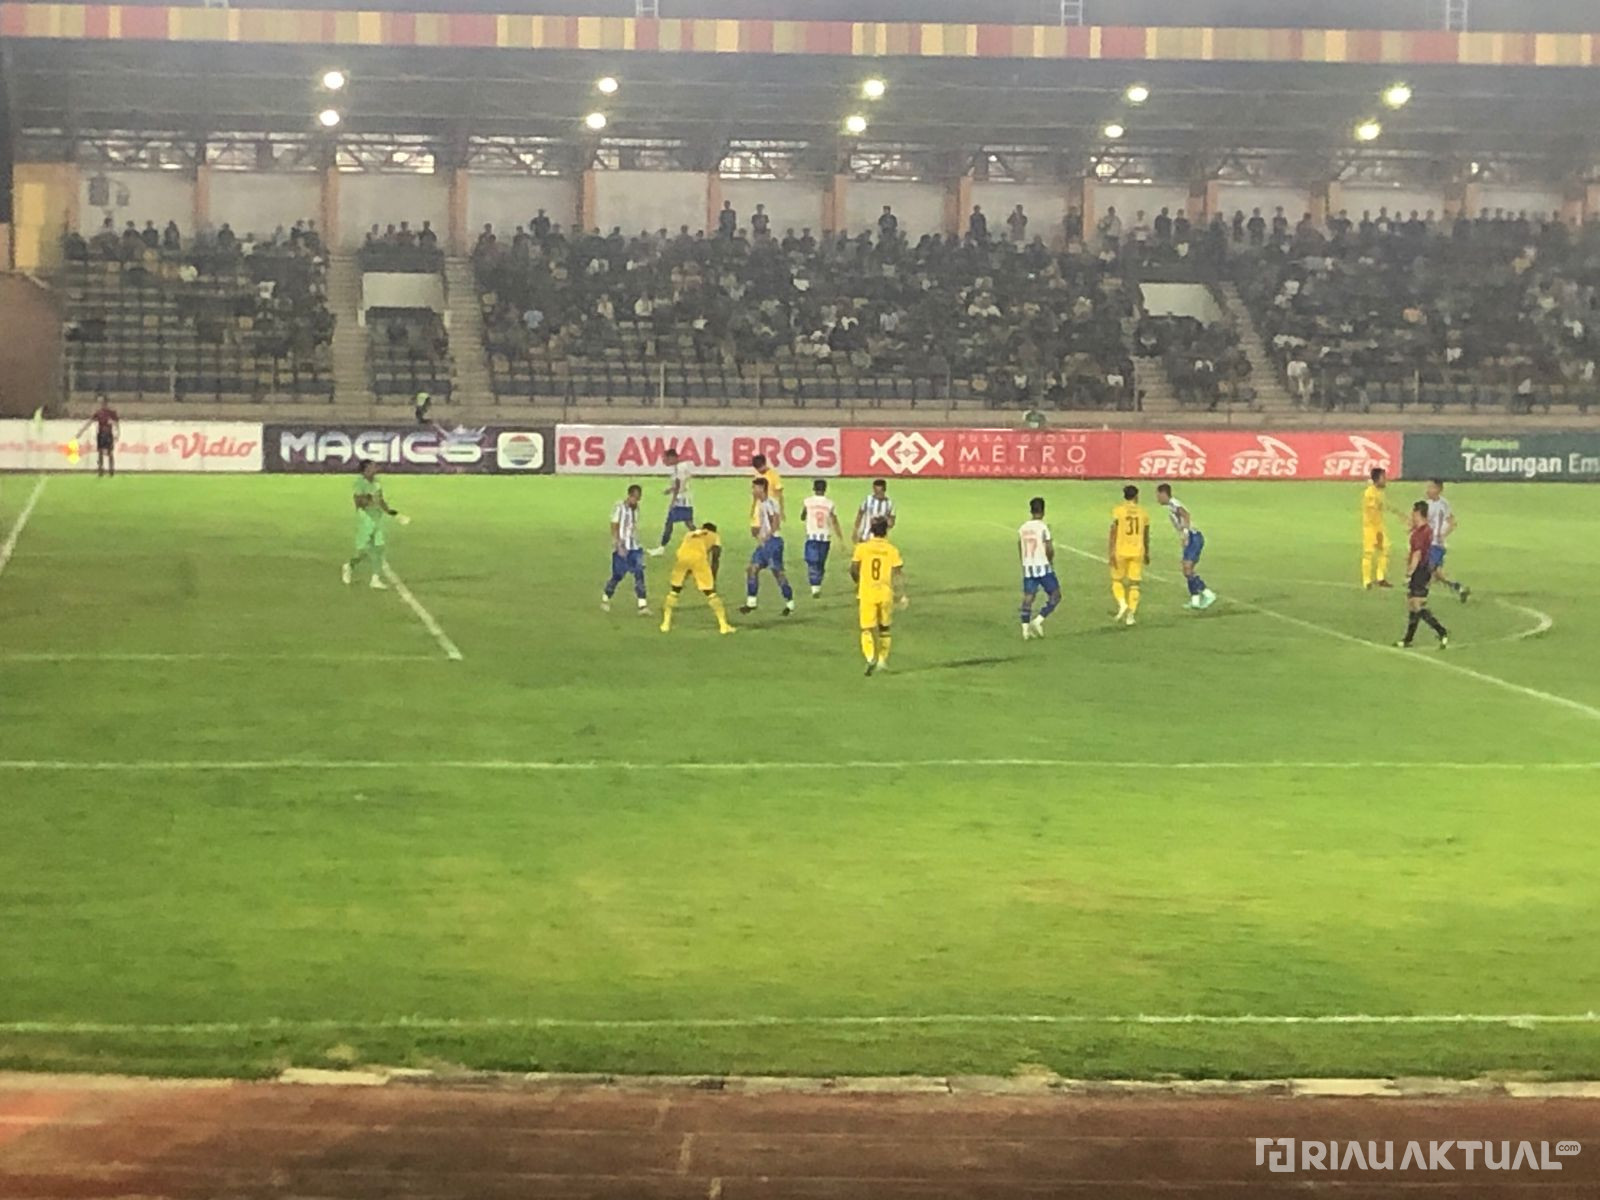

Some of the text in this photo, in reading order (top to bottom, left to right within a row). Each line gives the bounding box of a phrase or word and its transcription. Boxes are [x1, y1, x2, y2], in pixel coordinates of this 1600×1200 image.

[172, 432, 257, 459] Vidio
[558, 436, 838, 469] RS AWAL BROS
[958, 445, 1087, 464] METRO
[1138, 457, 1207, 475] SPECS
[1231, 458, 1299, 475] SPECS
[1323, 459, 1391, 476] SPECS
[1461, 453, 1562, 477] Tabungan
[1125, 516, 1139, 536] 31
[871, 558, 882, 580] 8
